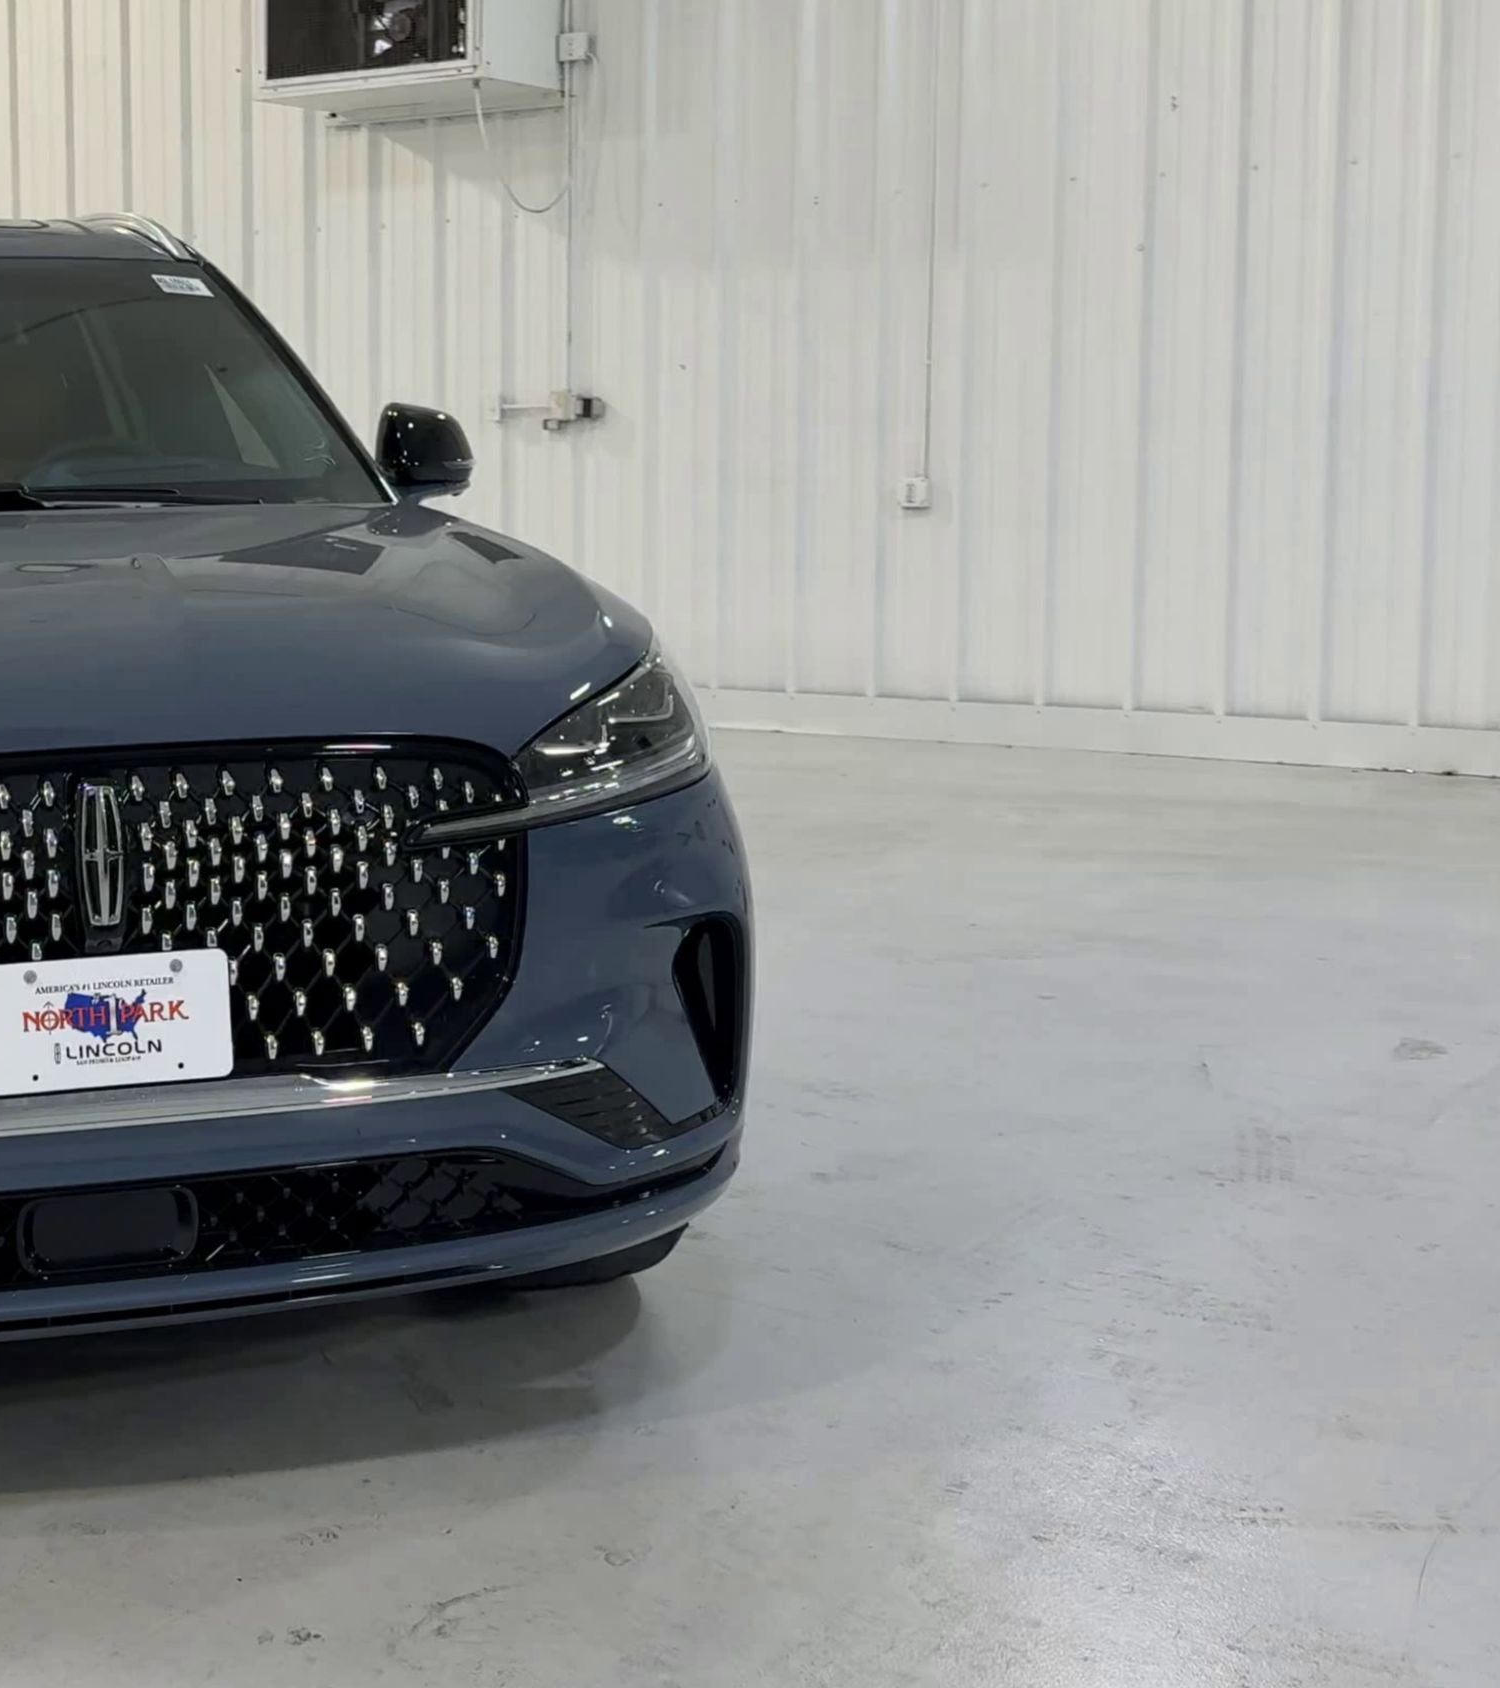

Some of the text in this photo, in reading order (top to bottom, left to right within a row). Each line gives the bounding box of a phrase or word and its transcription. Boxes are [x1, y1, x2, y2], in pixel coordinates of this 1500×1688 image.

[35, 983, 80, 995] AMERICA'S
[93, 979, 132, 991] LINCOLN
[134, 977, 174, 986] RETAILER
[22, 1000, 189, 1033] NORTH PARK
[66, 1039, 162, 1060] LINCOLN
